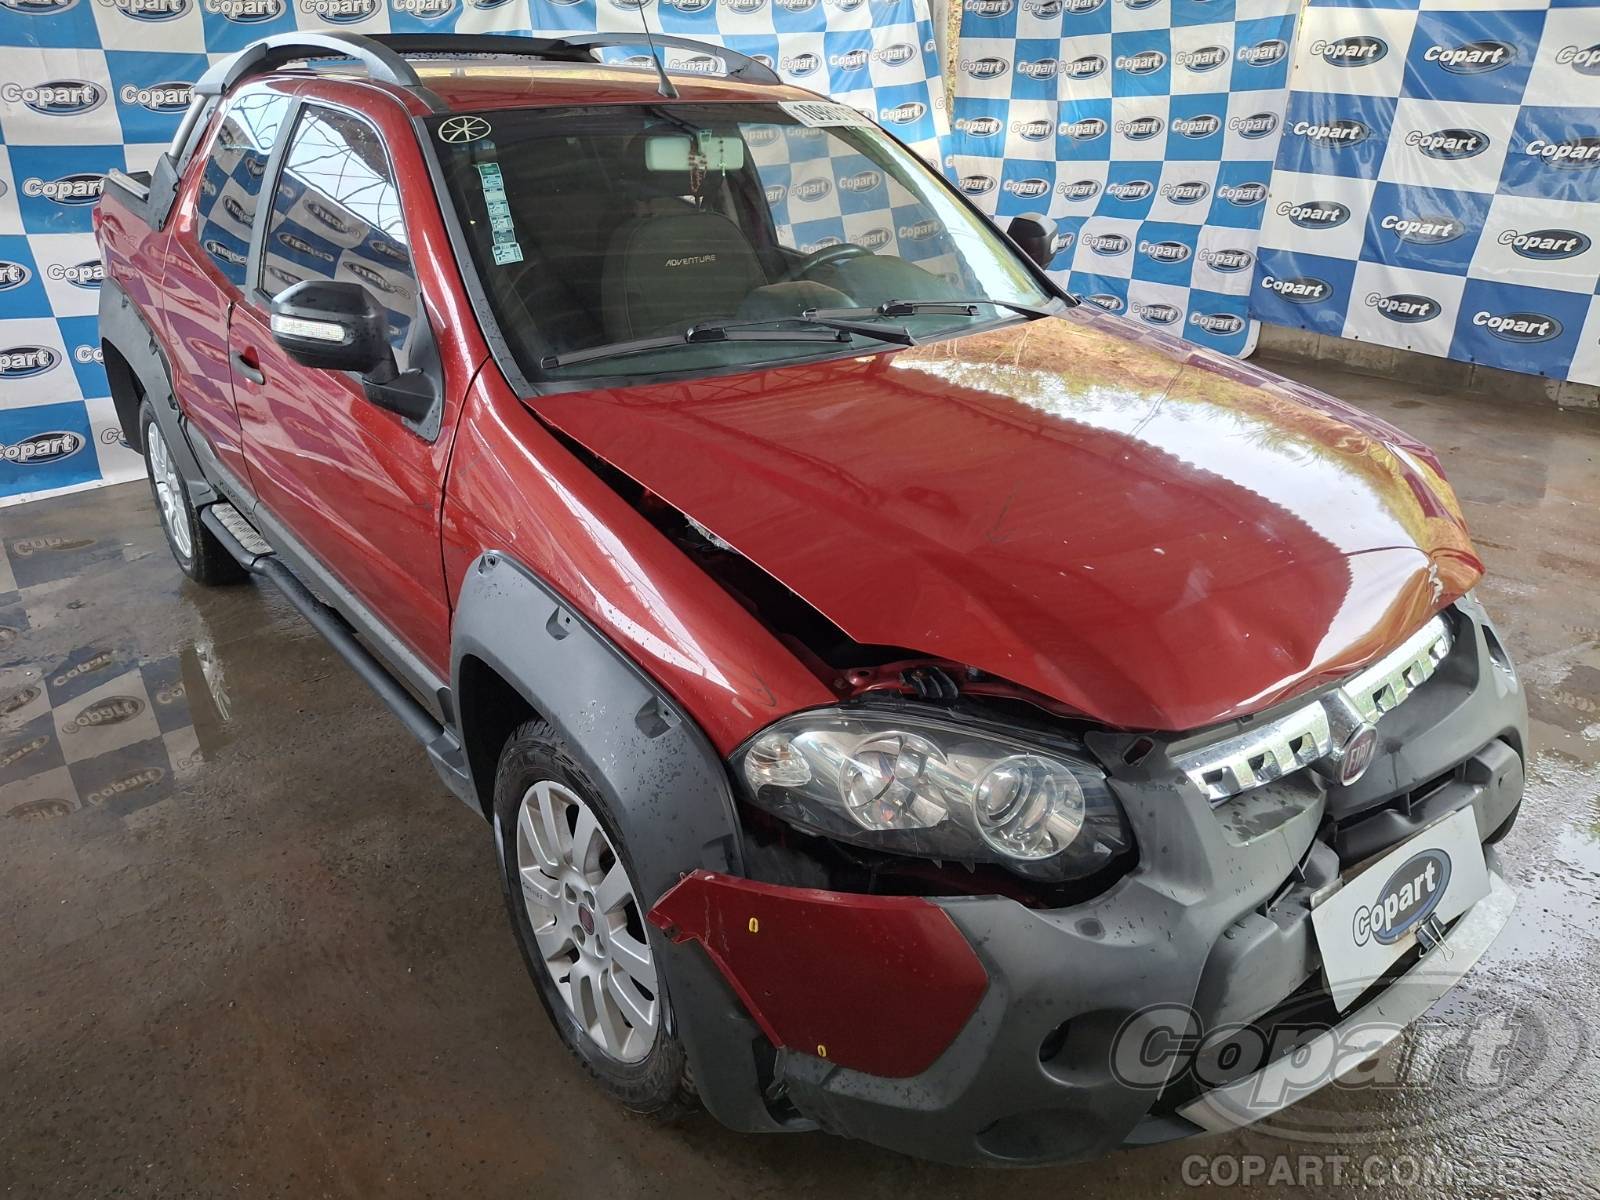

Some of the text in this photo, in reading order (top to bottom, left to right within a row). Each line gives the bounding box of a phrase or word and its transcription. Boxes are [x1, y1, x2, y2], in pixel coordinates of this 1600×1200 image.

[206, 0, 276, 17] Copart
[300, 0, 370, 17] Copart
[965, 0, 1006, 13] Copart
[870, 45, 911, 61] Copart
[1175, 46, 1226, 70] Copart
[1237, 41, 1284, 64] Copart
[1310, 39, 1378, 59] Copart
[1423, 45, 1504, 65] Copart
[1555, 45, 1600, 67] Cop
[781, 56, 816, 72] Copart
[960, 58, 1004, 75] Copart
[1017, 60, 1056, 76] Copart
[1059, 58, 1103, 76] Copart
[1115, 52, 1162, 73] Copart
[1, 83, 94, 105] Copart
[880, 105, 920, 121] Copart
[955, 118, 999, 134] Copart
[1010, 120, 1052, 138] Copart
[1057, 121, 1103, 139] Copart
[1114, 117, 1161, 138] Copart
[1171, 116, 1218, 138] Copart
[1227, 114, 1277, 137] Copart
[1293, 121, 1360, 140] Copart
[1405, 130, 1478, 151] Copart
[1525, 140, 1600, 160] Copar
[790, 181, 826, 198] Copart
[838, 174, 876, 190] Copart
[1003, 179, 1045, 194] Copart
[1056, 181, 1098, 200] Copart
[1107, 181, 1151, 200] Copart
[1160, 183, 1205, 201] Copart
[1217, 184, 1264, 204] Copart
[1276, 202, 1340, 222] Copart
[898, 221, 938, 238] Copart
[1381, 215, 1453, 237] Copart
[1082, 233, 1124, 251] Copart
[1139, 239, 1189, 260] Copart
[1498, 230, 1578, 252] Copart
[665, 254, 717, 267] ADVENTURE
[1199, 248, 1249, 268] Copart
[47, 263, 105, 282] Copa
[1261, 275, 1323, 297] Copart
[1132, 302, 1178, 322] Copart
[1365, 292, 1430, 316] Copart
[1189, 312, 1242, 332] Copart
[1472, 311, 1551, 336] Copart
[0, 350, 49, 372] part
[1353, 861, 1436, 947] Copart
